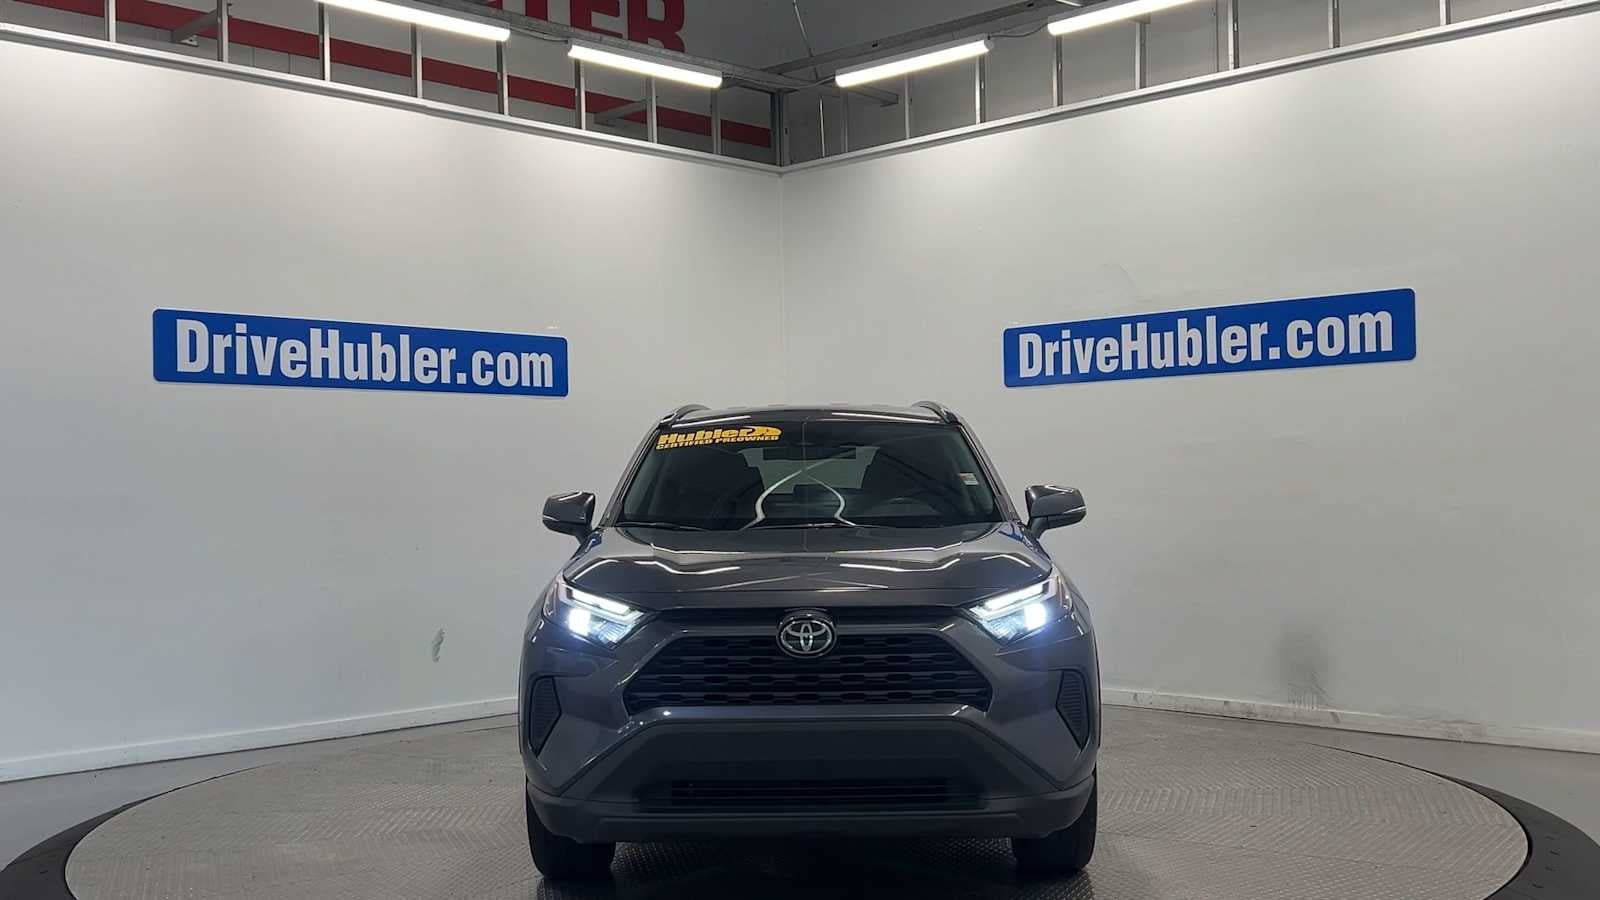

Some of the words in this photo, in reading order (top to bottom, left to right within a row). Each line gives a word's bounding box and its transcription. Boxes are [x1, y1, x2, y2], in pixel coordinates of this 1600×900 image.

[175, 318, 553, 388] DriveHubler.com
[1018, 309, 1393, 378] DriveHubler.com
[655, 438, 714, 450] CERTIFIED
[715, 435, 781, 444] PREOWNED
[656, 428, 754, 445] Hubler
